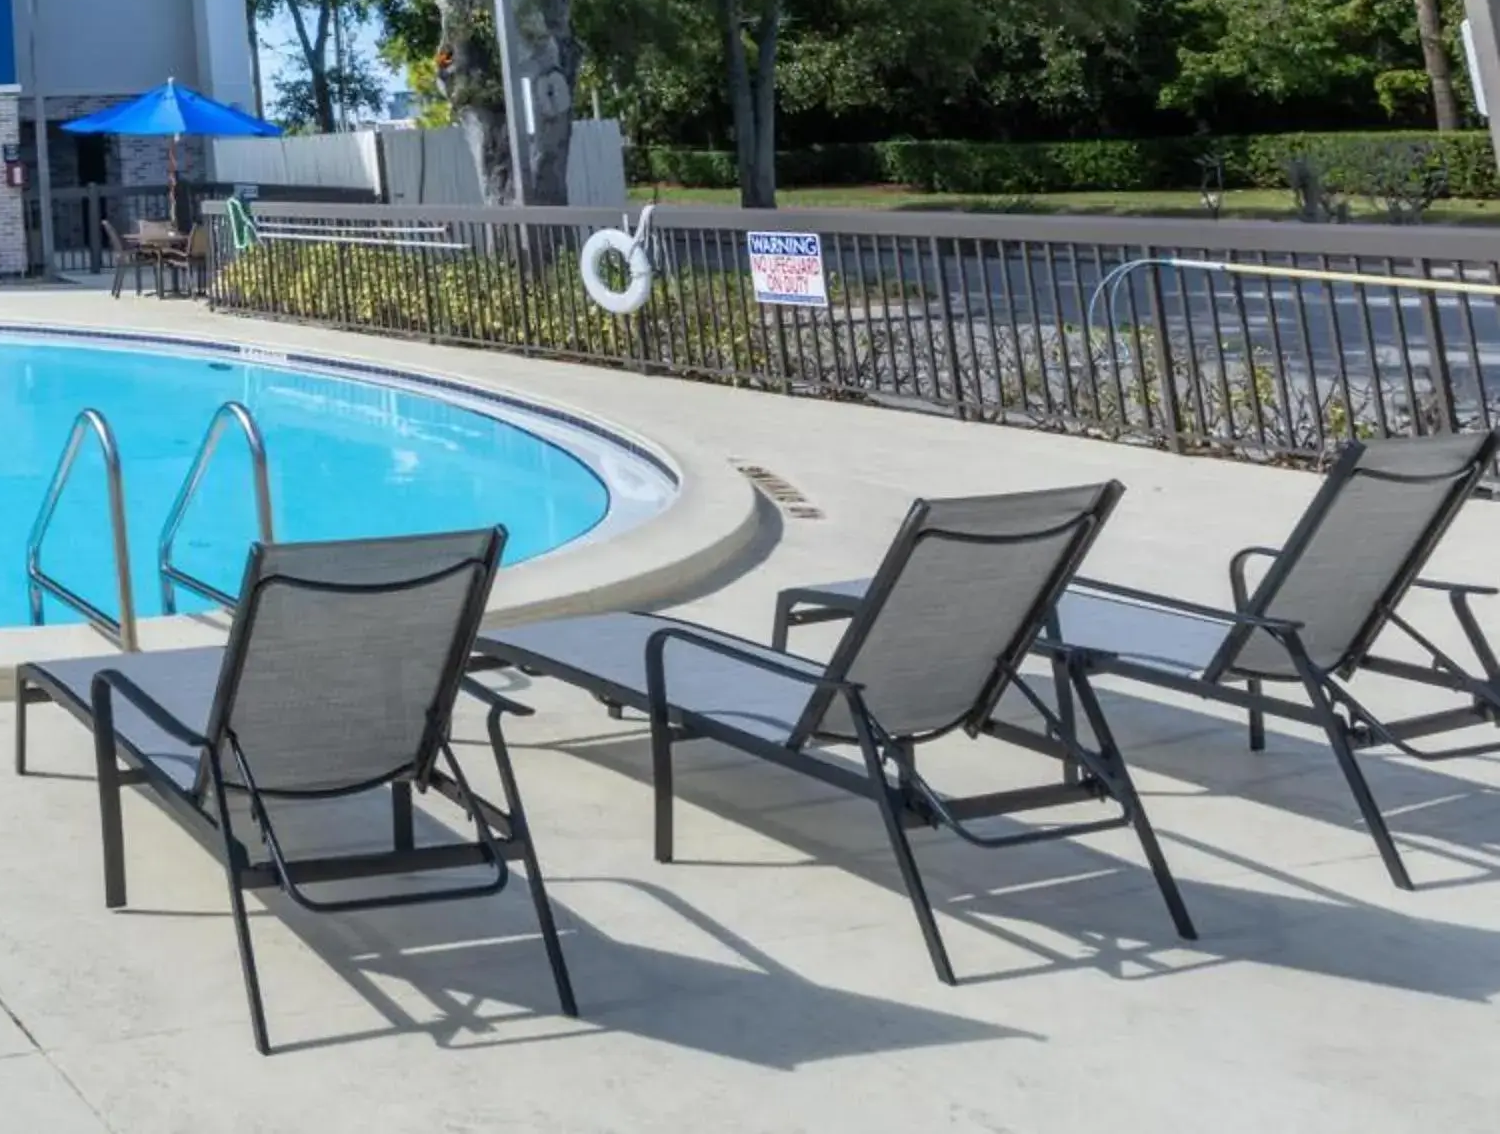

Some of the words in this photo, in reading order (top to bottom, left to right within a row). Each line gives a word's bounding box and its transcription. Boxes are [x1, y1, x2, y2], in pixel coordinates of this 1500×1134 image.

[751, 237, 817, 255] WARNING
[753, 256, 767, 273] NO
[784, 275, 808, 293] DUTY
